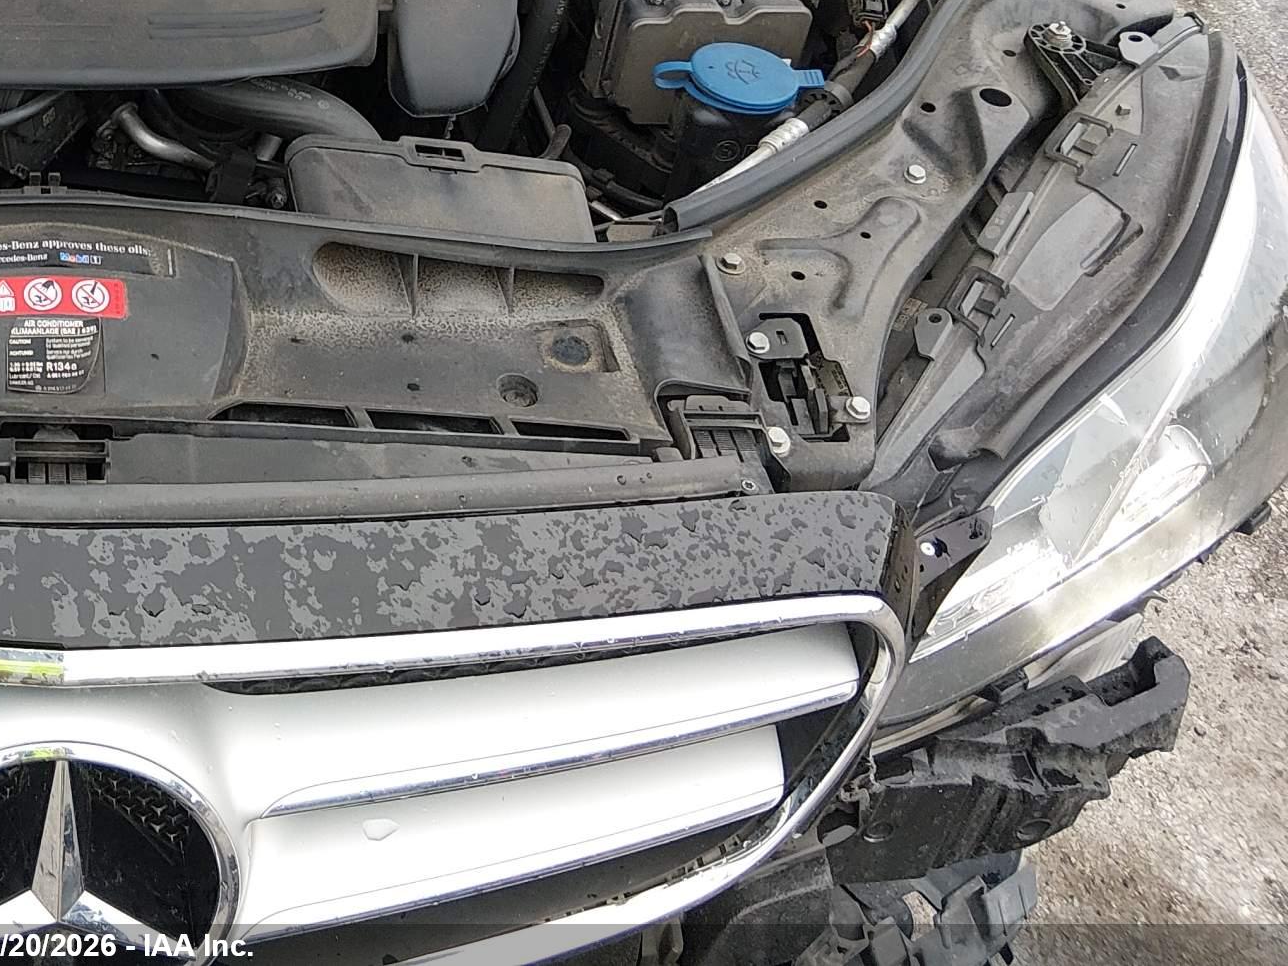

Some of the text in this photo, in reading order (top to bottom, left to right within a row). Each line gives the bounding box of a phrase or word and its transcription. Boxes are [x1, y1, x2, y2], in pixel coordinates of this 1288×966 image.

[41, 239, 93, 251] approves
[95, 242, 126, 253] these
[24, 319, 36, 328] AIR
